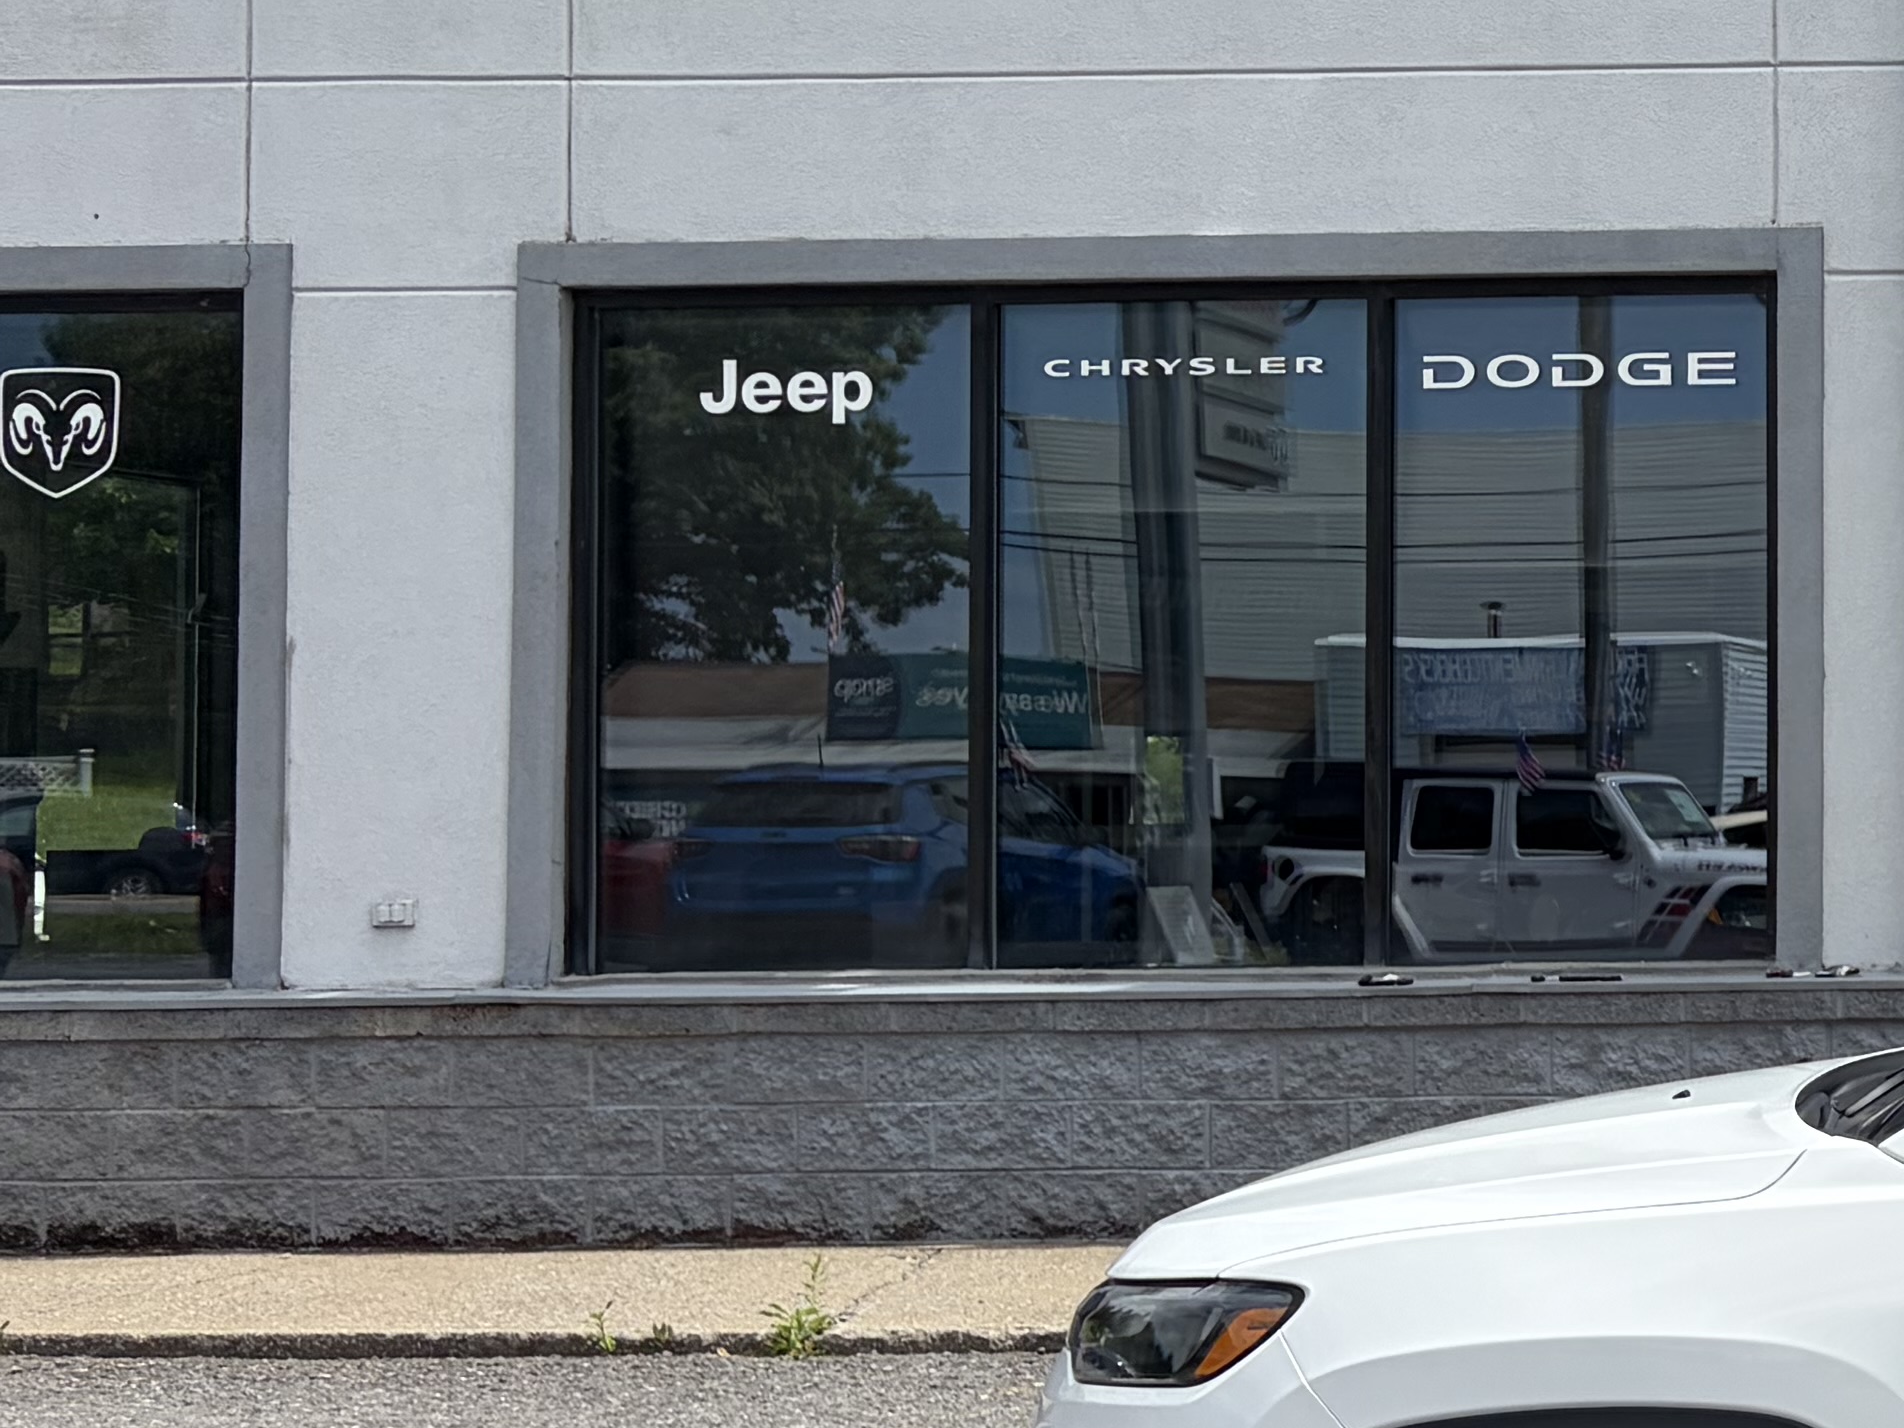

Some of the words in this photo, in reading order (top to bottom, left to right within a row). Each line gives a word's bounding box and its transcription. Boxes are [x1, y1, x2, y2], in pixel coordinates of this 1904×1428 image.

[1044, 355, 1324, 377] CHRYSLER
[1422, 351, 1737, 389] DODGE
[699, 359, 874, 424] Jeep
